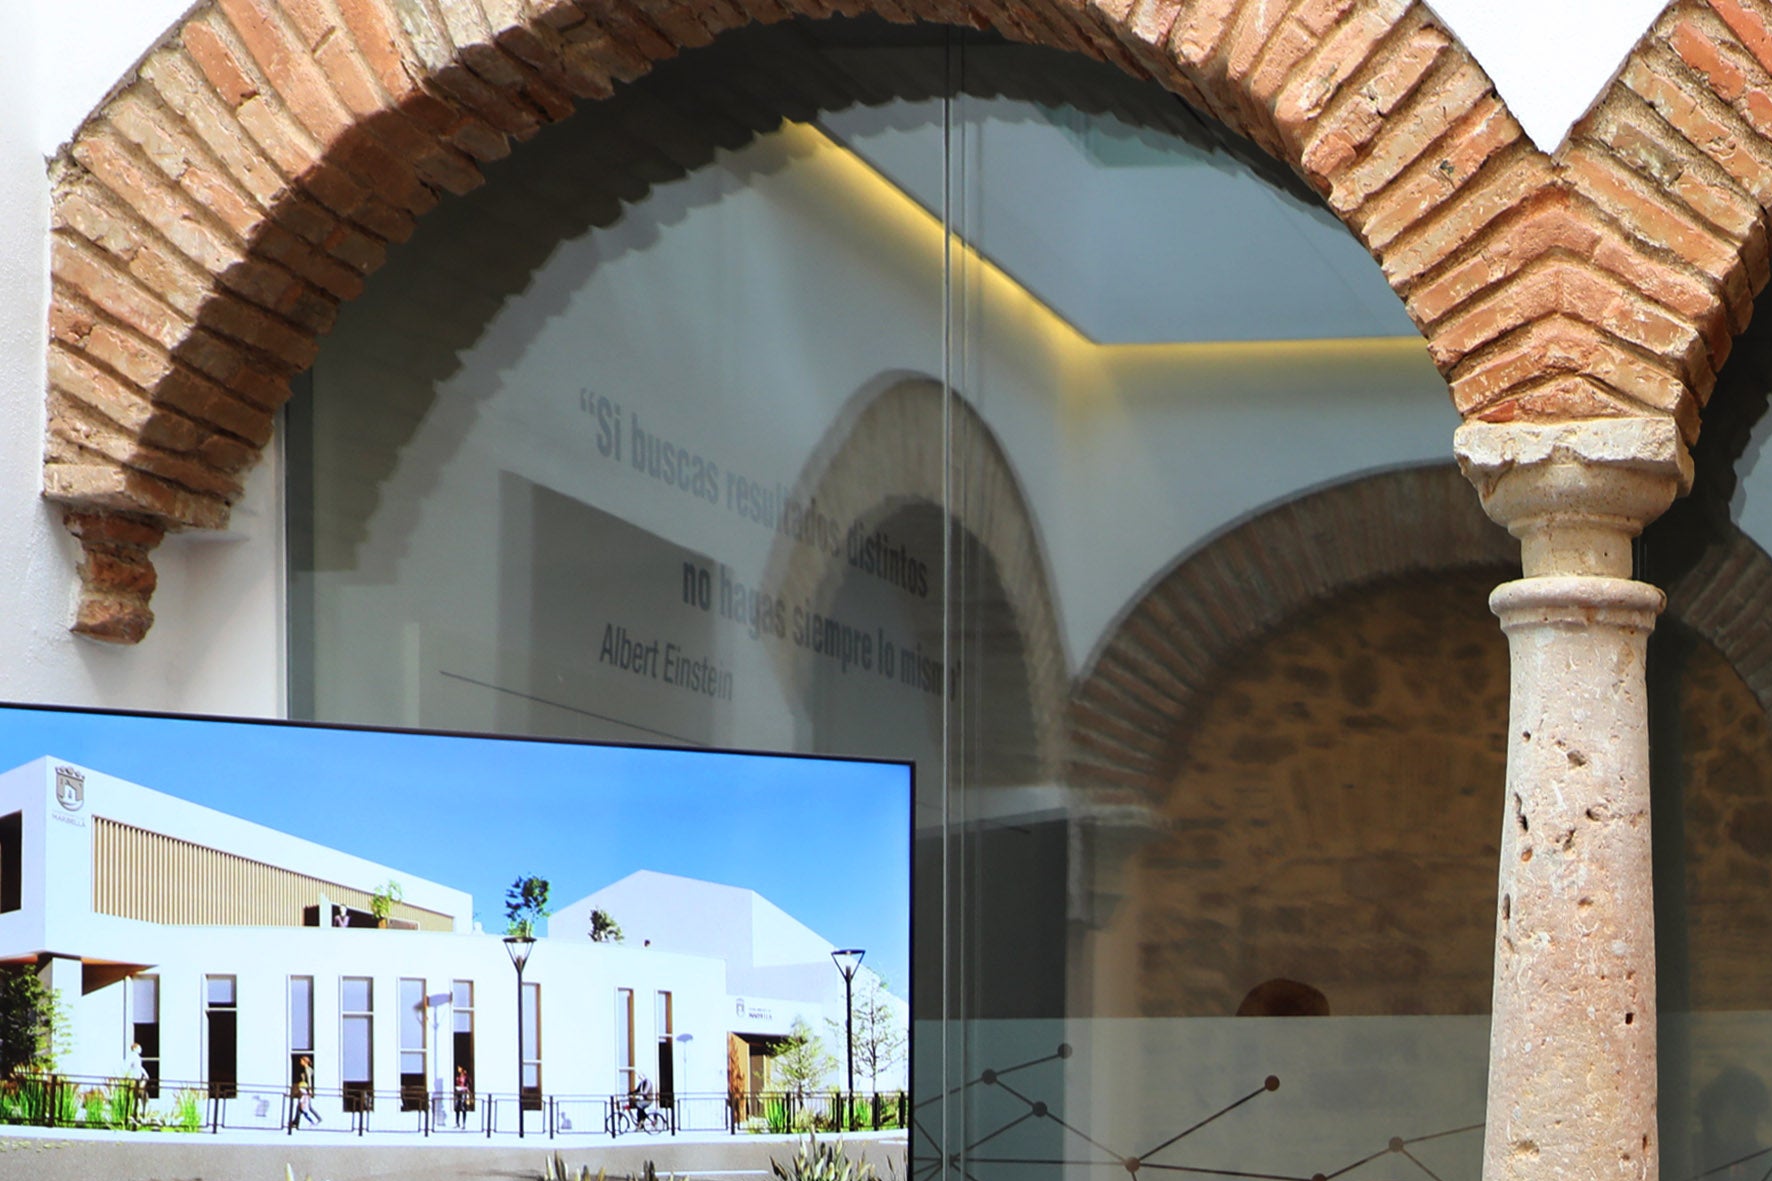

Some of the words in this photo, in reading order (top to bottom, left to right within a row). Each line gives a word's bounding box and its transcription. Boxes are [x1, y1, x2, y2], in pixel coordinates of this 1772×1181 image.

[631, 411, 720, 505] buscas
[726, 469, 841, 558] resultados
[846, 516, 929, 599] distintos
[599, 622, 660, 679] Albert
[663, 639, 735, 701] Einstein
[682, 560, 711, 612] no
[719, 562, 786, 641] hagas
[792, 597, 873, 675] siempre
[877, 626, 895, 680] lo
